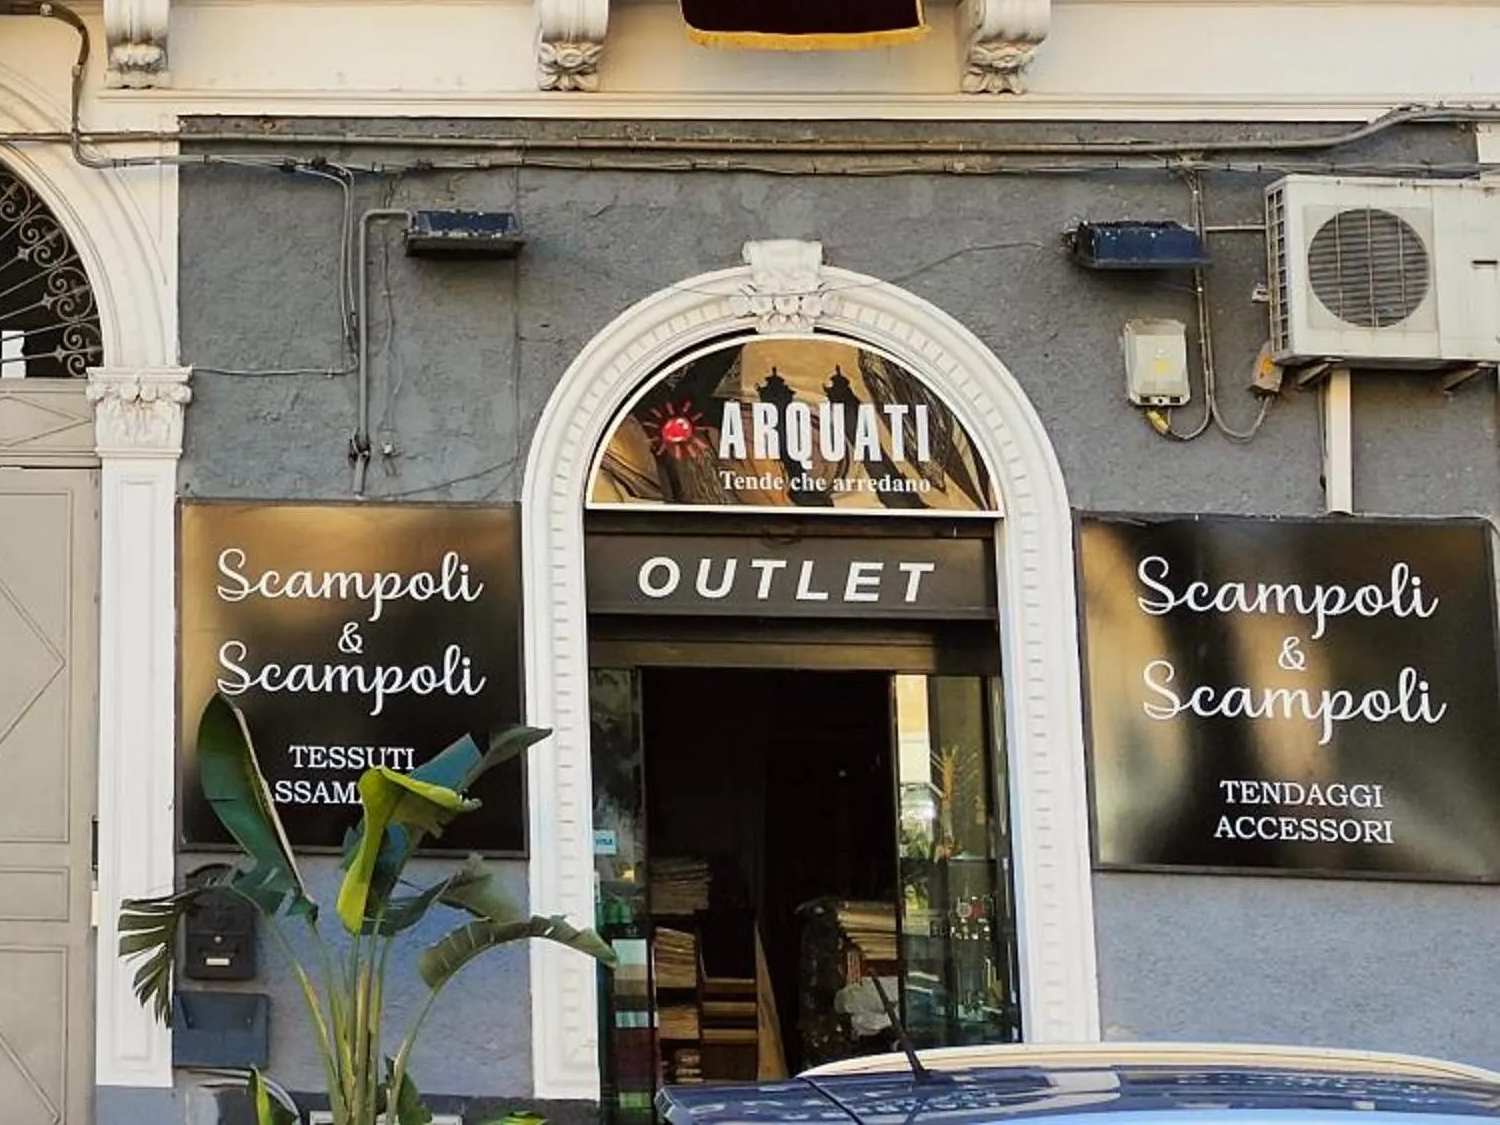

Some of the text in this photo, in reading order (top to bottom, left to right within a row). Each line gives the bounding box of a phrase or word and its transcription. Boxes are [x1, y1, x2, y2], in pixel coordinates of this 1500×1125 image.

[718, 401, 931, 470] ARQUATI
[719, 470, 931, 493] Tende che arredano
[216, 548, 484, 622] Scampoli
[637, 556, 936, 603] OUTLET
[1137, 556, 1439, 640] Scampoli
[337, 622, 365, 655] &
[1277, 636, 1307, 671] &
[216, 640, 487, 717] Scampoli
[1142, 660, 1448, 745] Scampoli
[288, 744, 416, 771] TESSUTI
[1220, 780, 1384, 808] TENDAGGI
[1214, 816, 1395, 844] ACCESSORI
